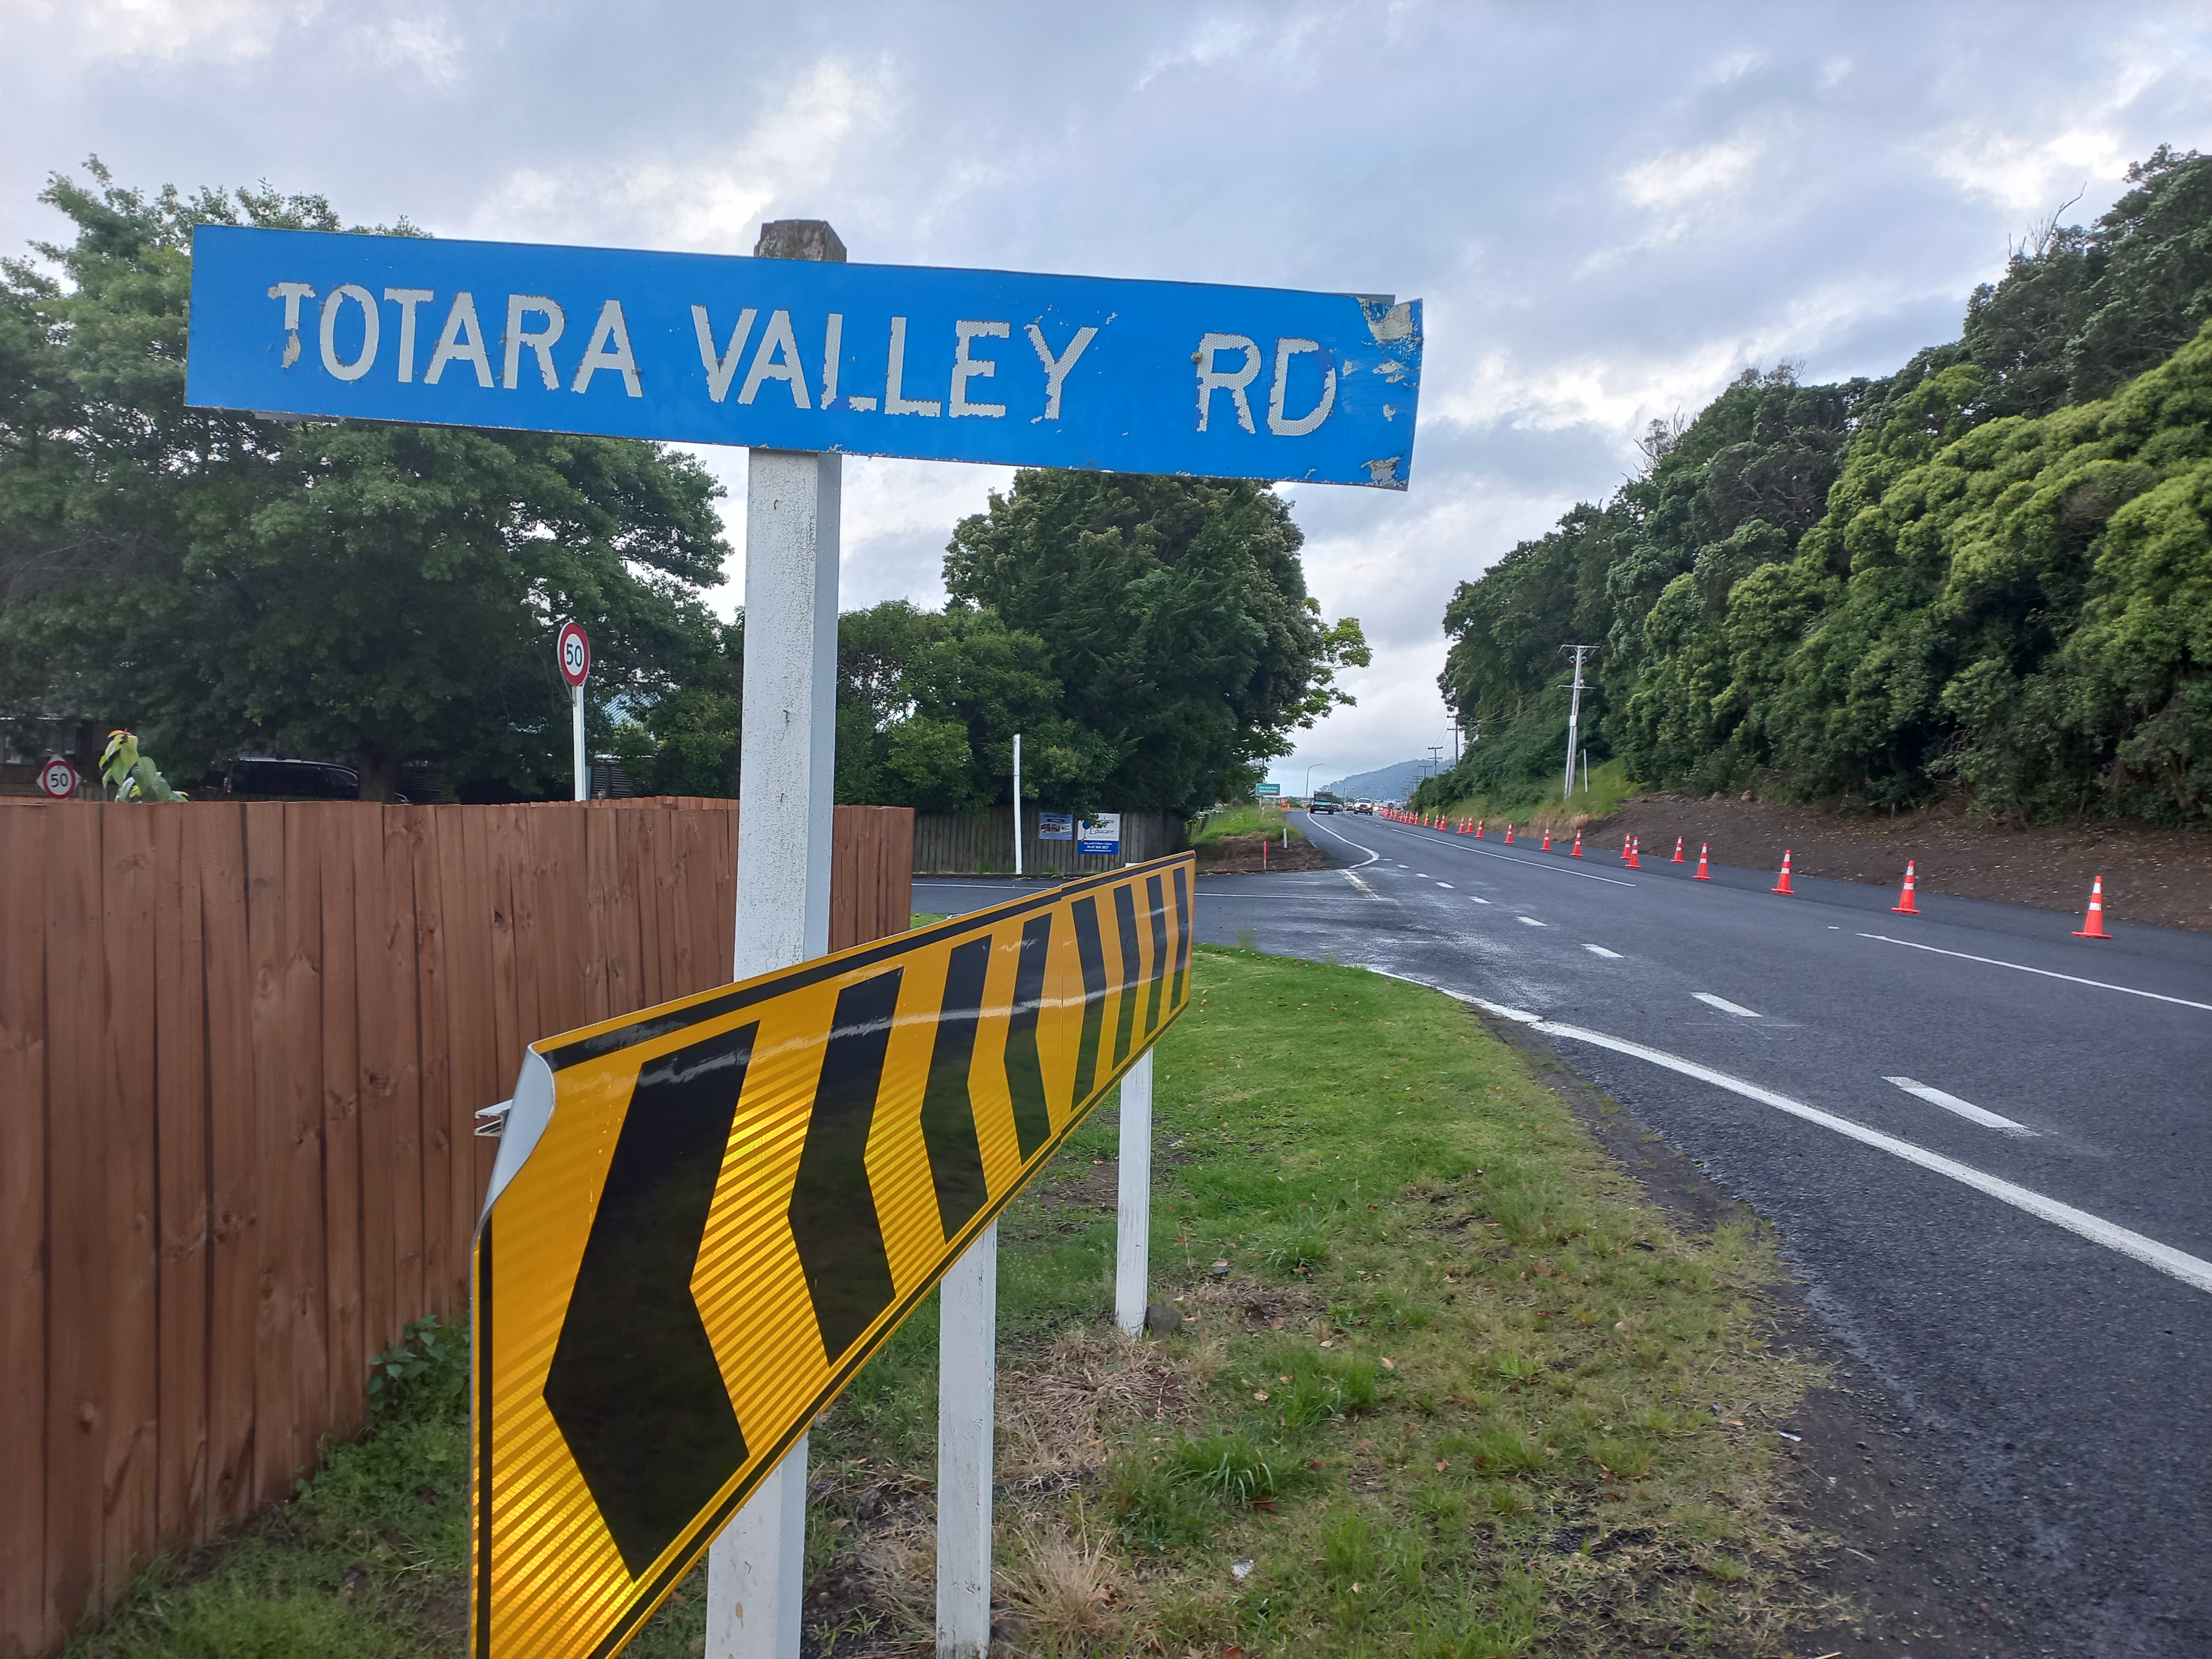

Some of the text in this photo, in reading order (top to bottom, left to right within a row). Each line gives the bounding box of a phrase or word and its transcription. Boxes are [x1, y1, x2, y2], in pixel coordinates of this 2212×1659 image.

[268, 282, 1337, 436] TOTARA VALLEY RD
[566, 643, 582, 667] 50
[51, 773, 68, 787] 50
